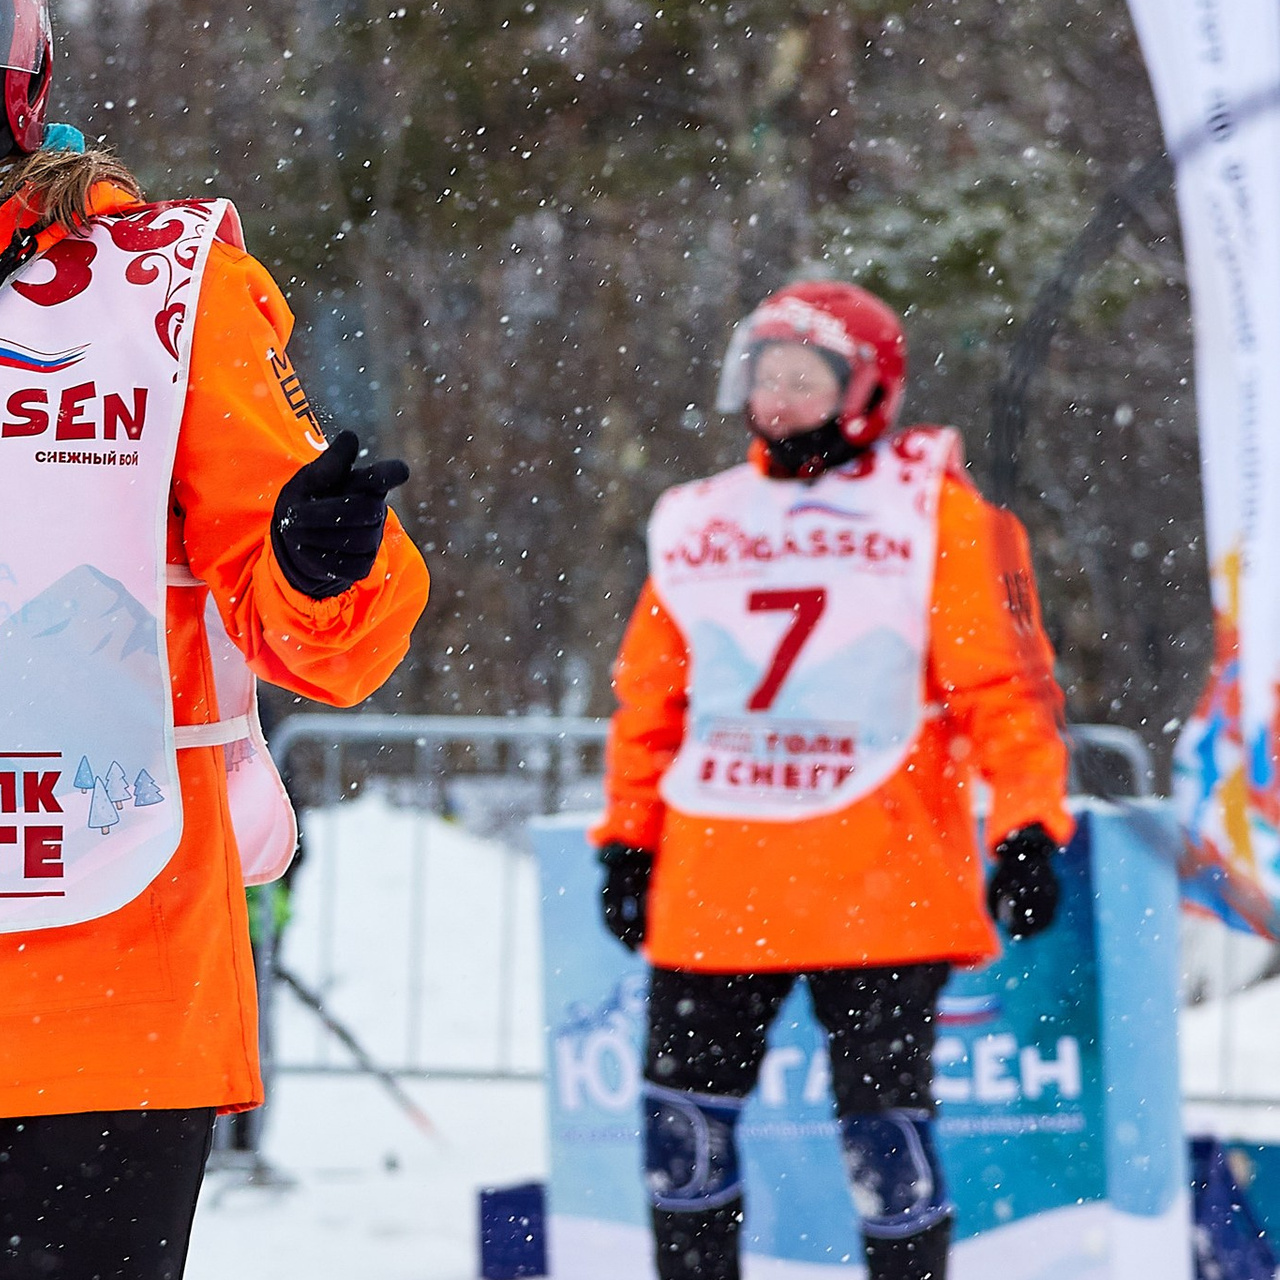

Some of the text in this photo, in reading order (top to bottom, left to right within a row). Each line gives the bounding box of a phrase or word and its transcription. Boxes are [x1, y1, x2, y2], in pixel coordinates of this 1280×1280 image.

[35, 450, 139, 466] СНЕЖНЫЙ БОЙ
[746, 586, 827, 712] 7
